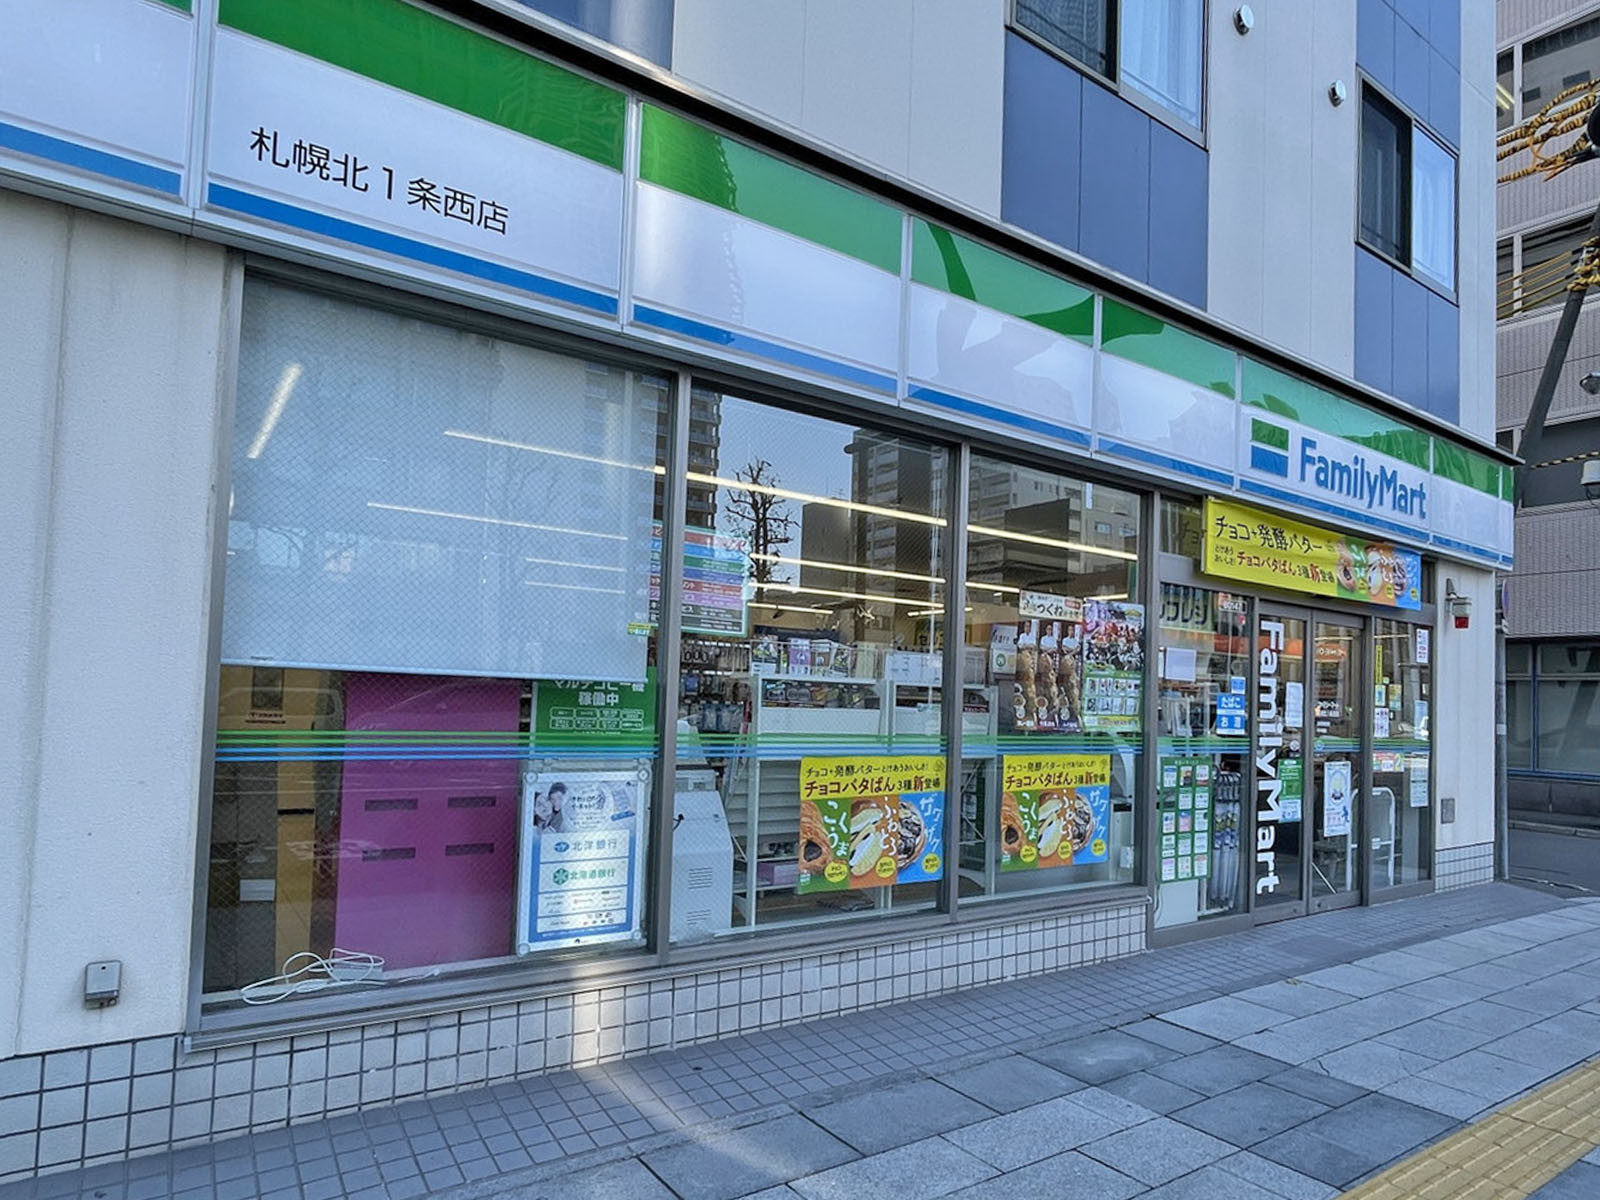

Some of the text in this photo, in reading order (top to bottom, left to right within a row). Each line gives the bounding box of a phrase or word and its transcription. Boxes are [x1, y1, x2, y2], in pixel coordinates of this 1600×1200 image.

[250, 126, 510, 235] 札幌北1条西店
[1300, 436, 1427, 519] FamilyMart
[1256, 621, 1284, 895] FamilyMart
